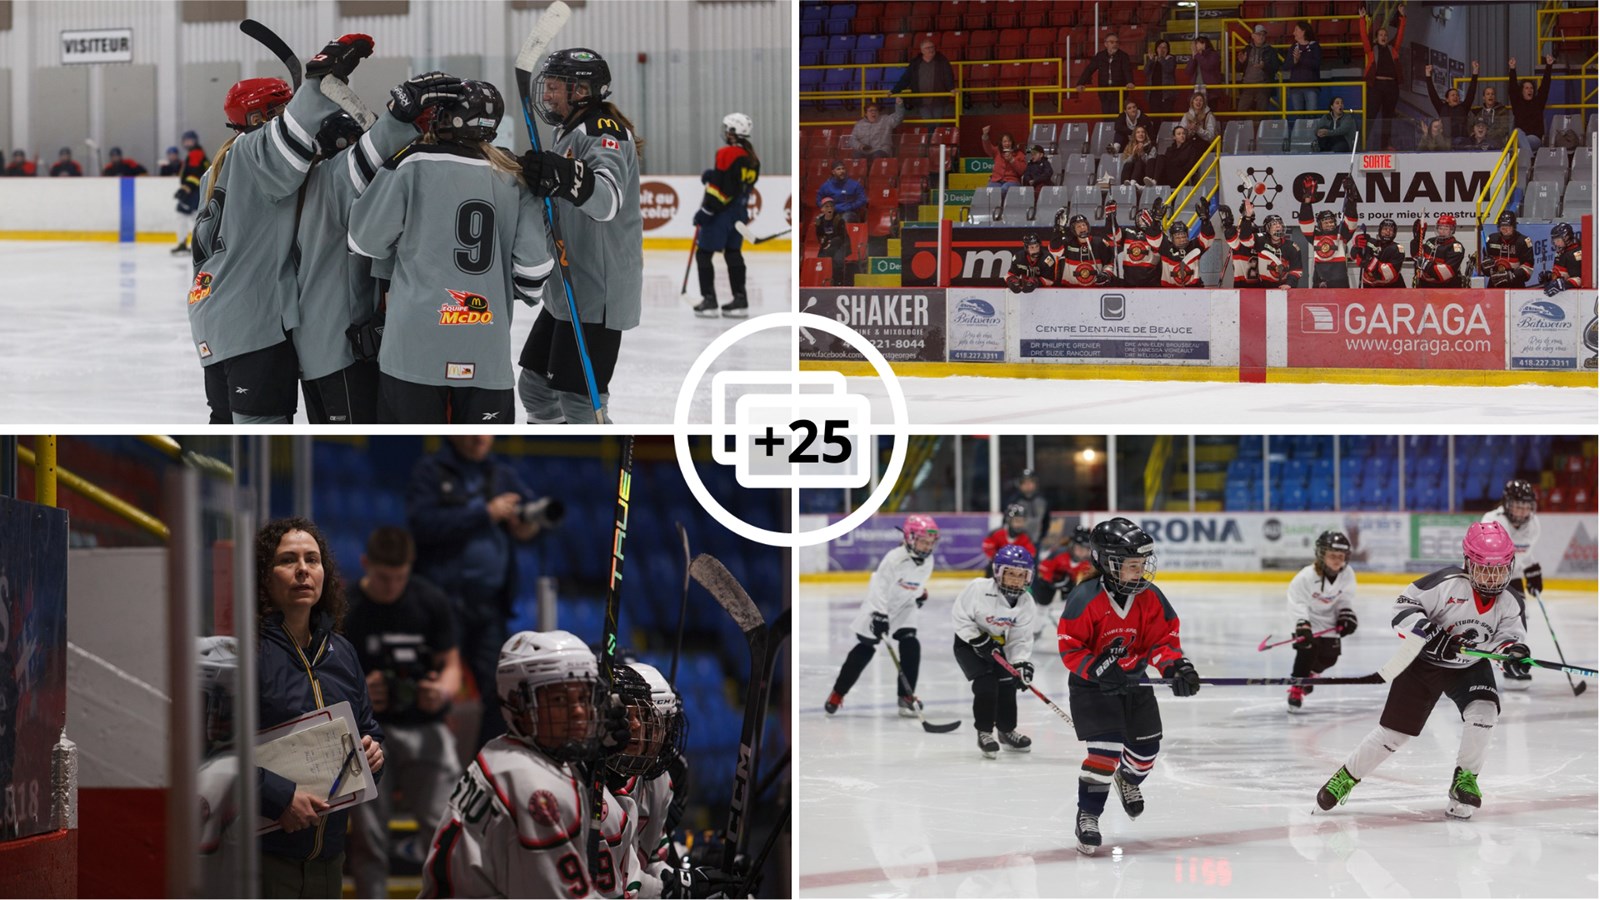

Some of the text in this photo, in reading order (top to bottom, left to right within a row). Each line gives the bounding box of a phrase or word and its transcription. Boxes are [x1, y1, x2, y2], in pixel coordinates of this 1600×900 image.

[63, 37, 129, 53] VISITEUR
[1363, 154, 1392, 169] SORTIE
[570, 160, 584, 198] CM
[1292, 171, 1491, 203] CANAM
[1368, 211, 1394, 221] pour
[1396, 210, 1430, 219] mieux
[1433, 210, 1490, 219] construe
[454, 199, 496, 275] 9
[836, 295, 929, 326] SHAKER
[1344, 302, 1491, 335] GARAGA
[1035, 324, 1076, 333] CENTRE
[1079, 325, 1130, 333] DENTAIRE
[1149, 325, 1193, 334] BEAUCE
[1346, 338, 1491, 356] www.garaga.com
[610, 468, 631, 591] TRUE
[1141, 519, 1244, 542] RONA
[726, 743, 752, 843] CCM
